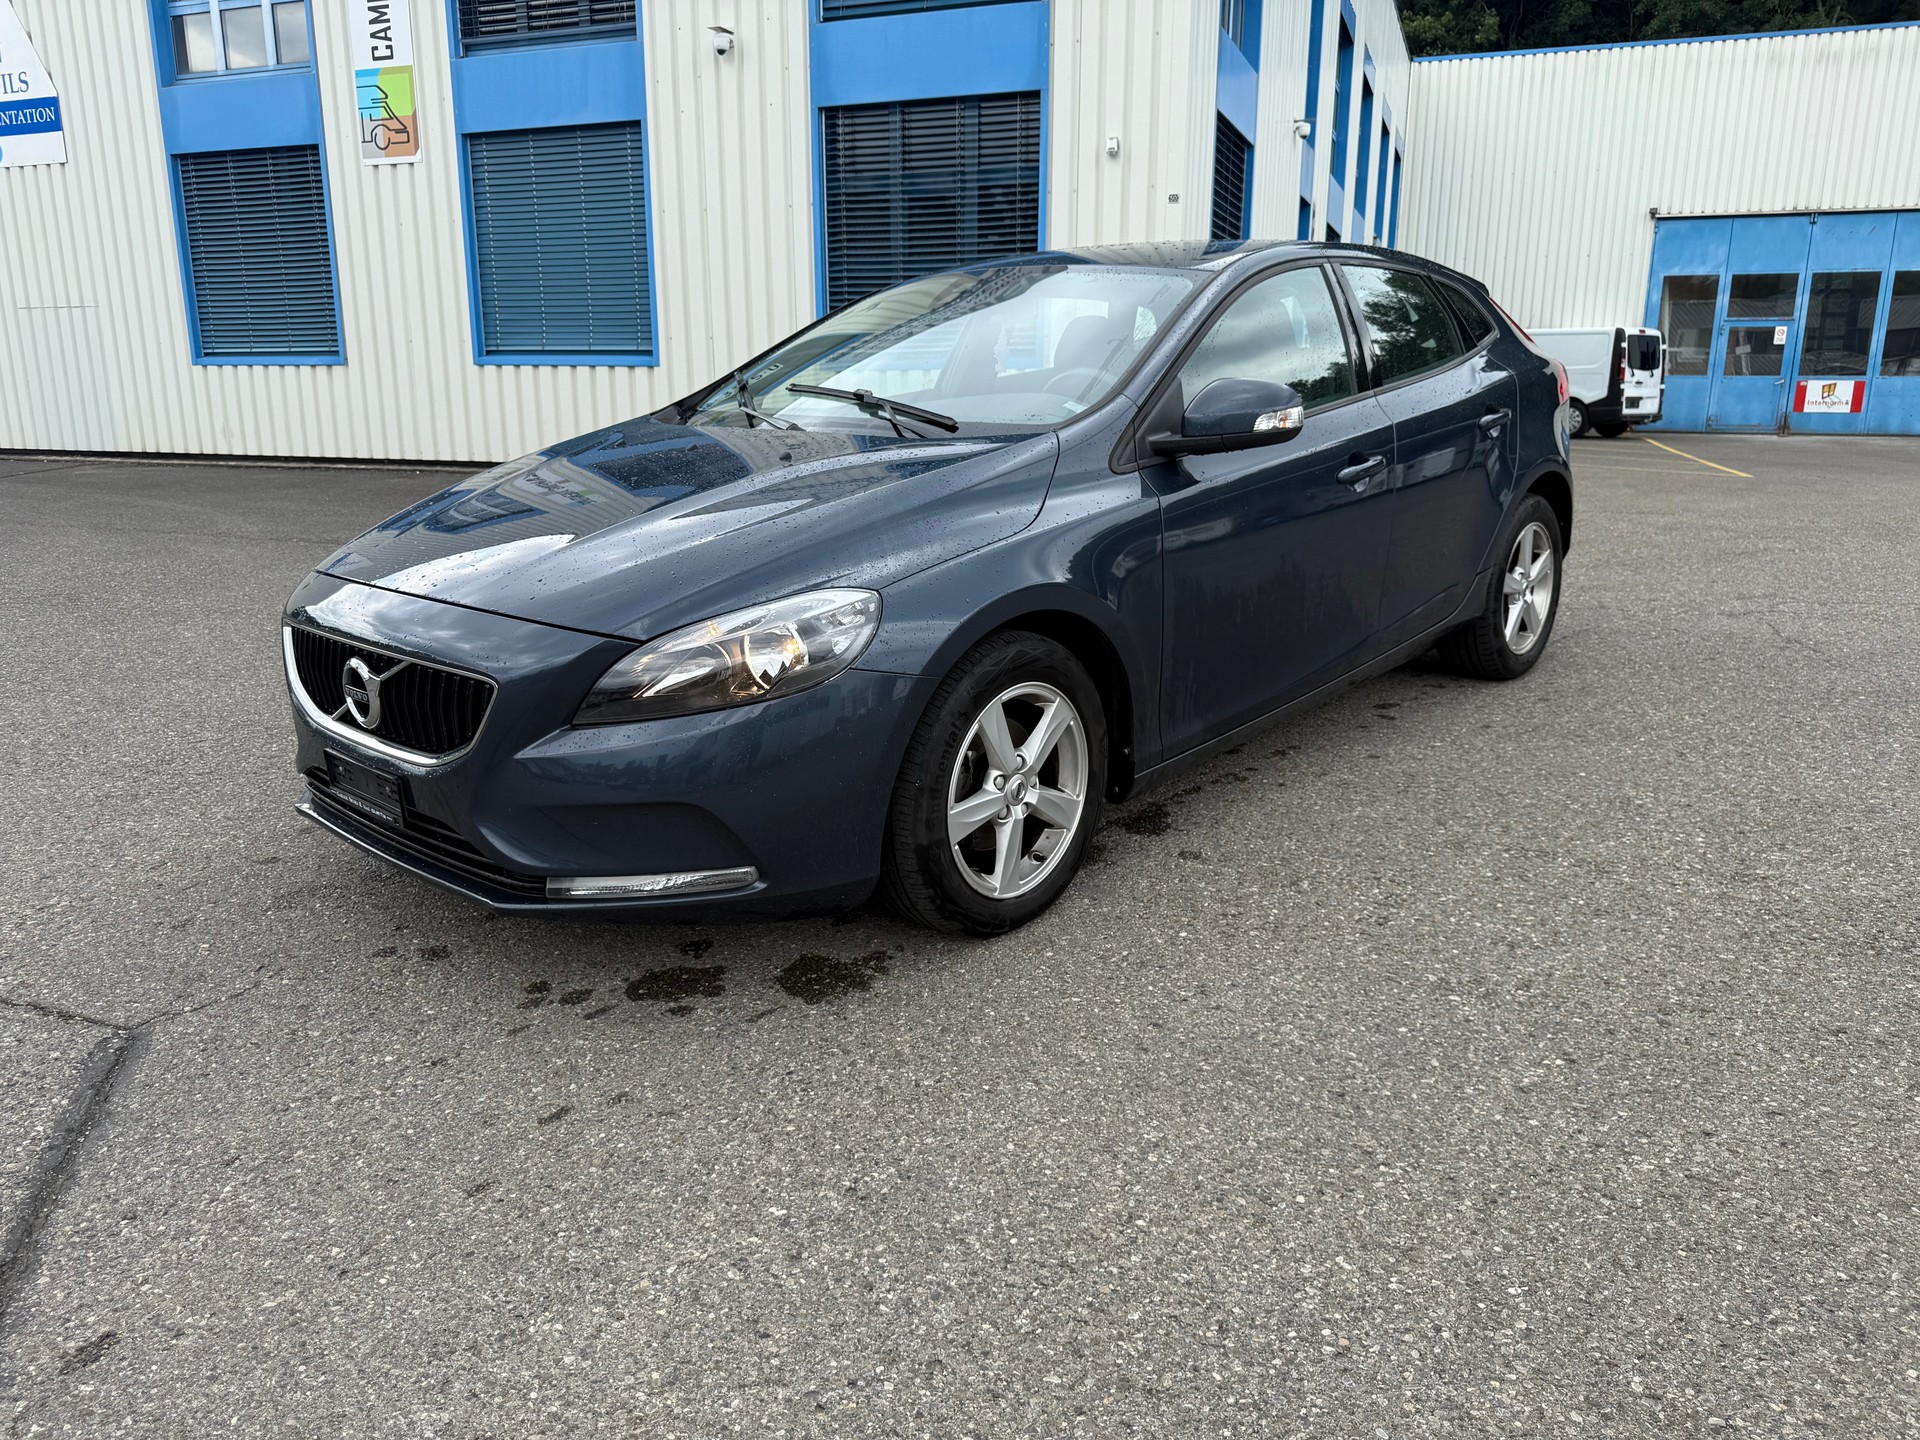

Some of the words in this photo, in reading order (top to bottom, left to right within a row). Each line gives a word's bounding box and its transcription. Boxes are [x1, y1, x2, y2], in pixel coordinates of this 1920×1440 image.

[366, 0, 394, 61] CAM
[0, 71, 29, 94] ILS
[0, 107, 55, 126] NTATION
[345, 687, 368, 702] VOLVO
